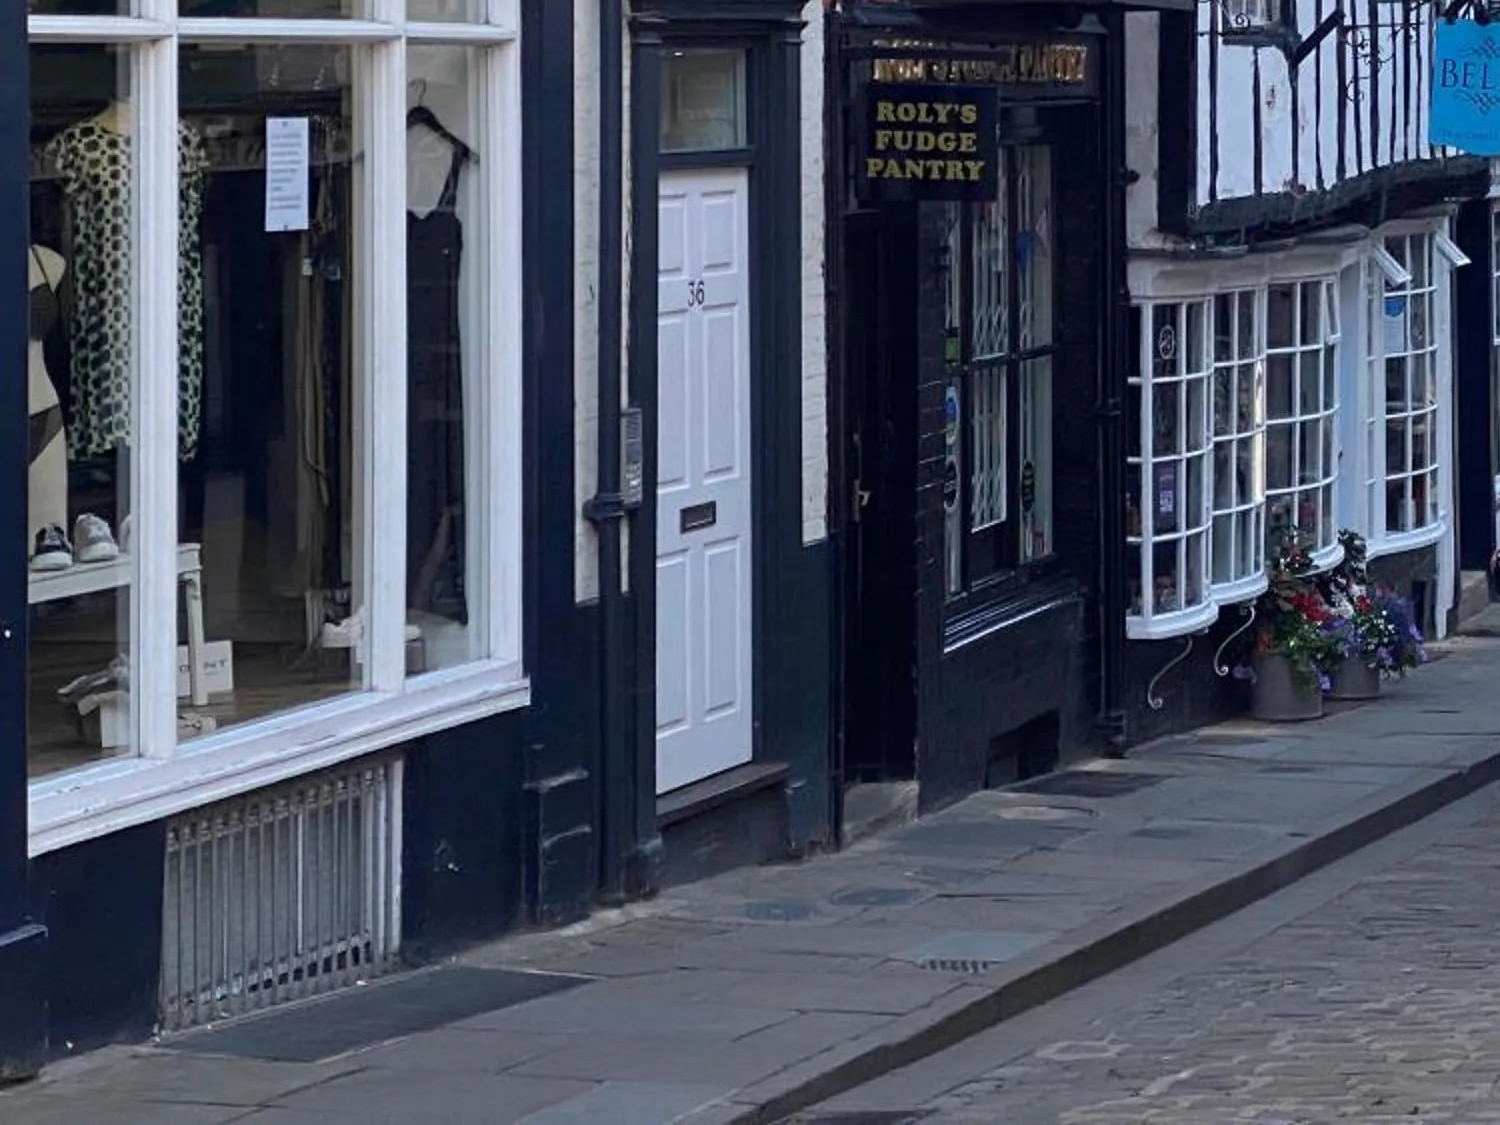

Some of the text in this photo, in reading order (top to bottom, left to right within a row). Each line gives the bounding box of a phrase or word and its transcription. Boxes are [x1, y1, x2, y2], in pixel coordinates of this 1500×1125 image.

[876, 101, 978, 125] ROLY'S
[875, 130, 977, 153] FUDGE
[866, 158, 986, 181] PANTRY
[688, 280, 705, 307] 36
